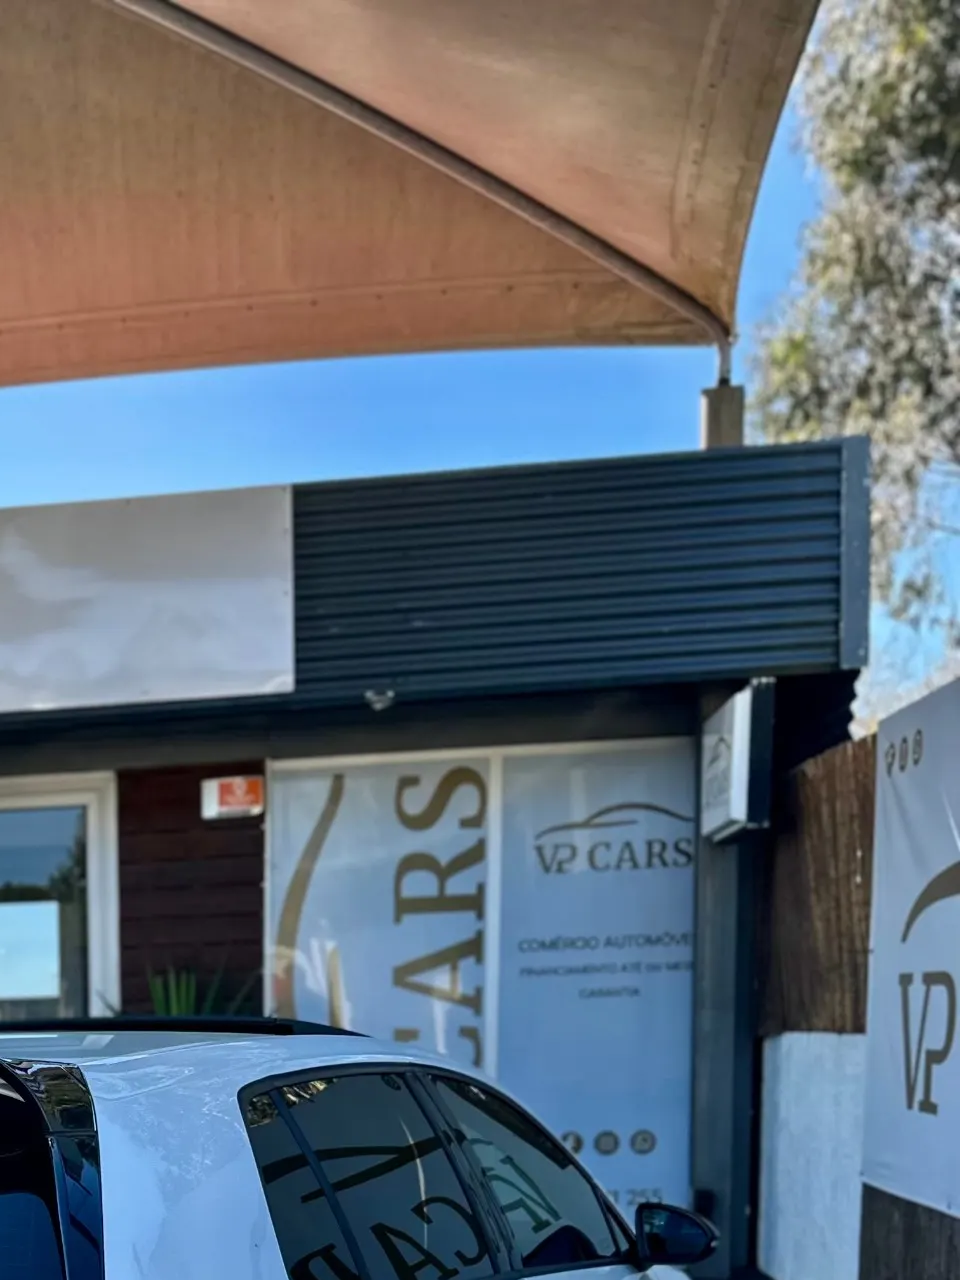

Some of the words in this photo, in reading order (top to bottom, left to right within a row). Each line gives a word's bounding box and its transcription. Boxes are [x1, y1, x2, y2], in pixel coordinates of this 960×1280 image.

[534, 843, 577, 874] VP
[587, 837, 693, 872] CARS
[603, 930, 693, 948] AUTOMÓVE
[899, 971, 957, 1116] VP
